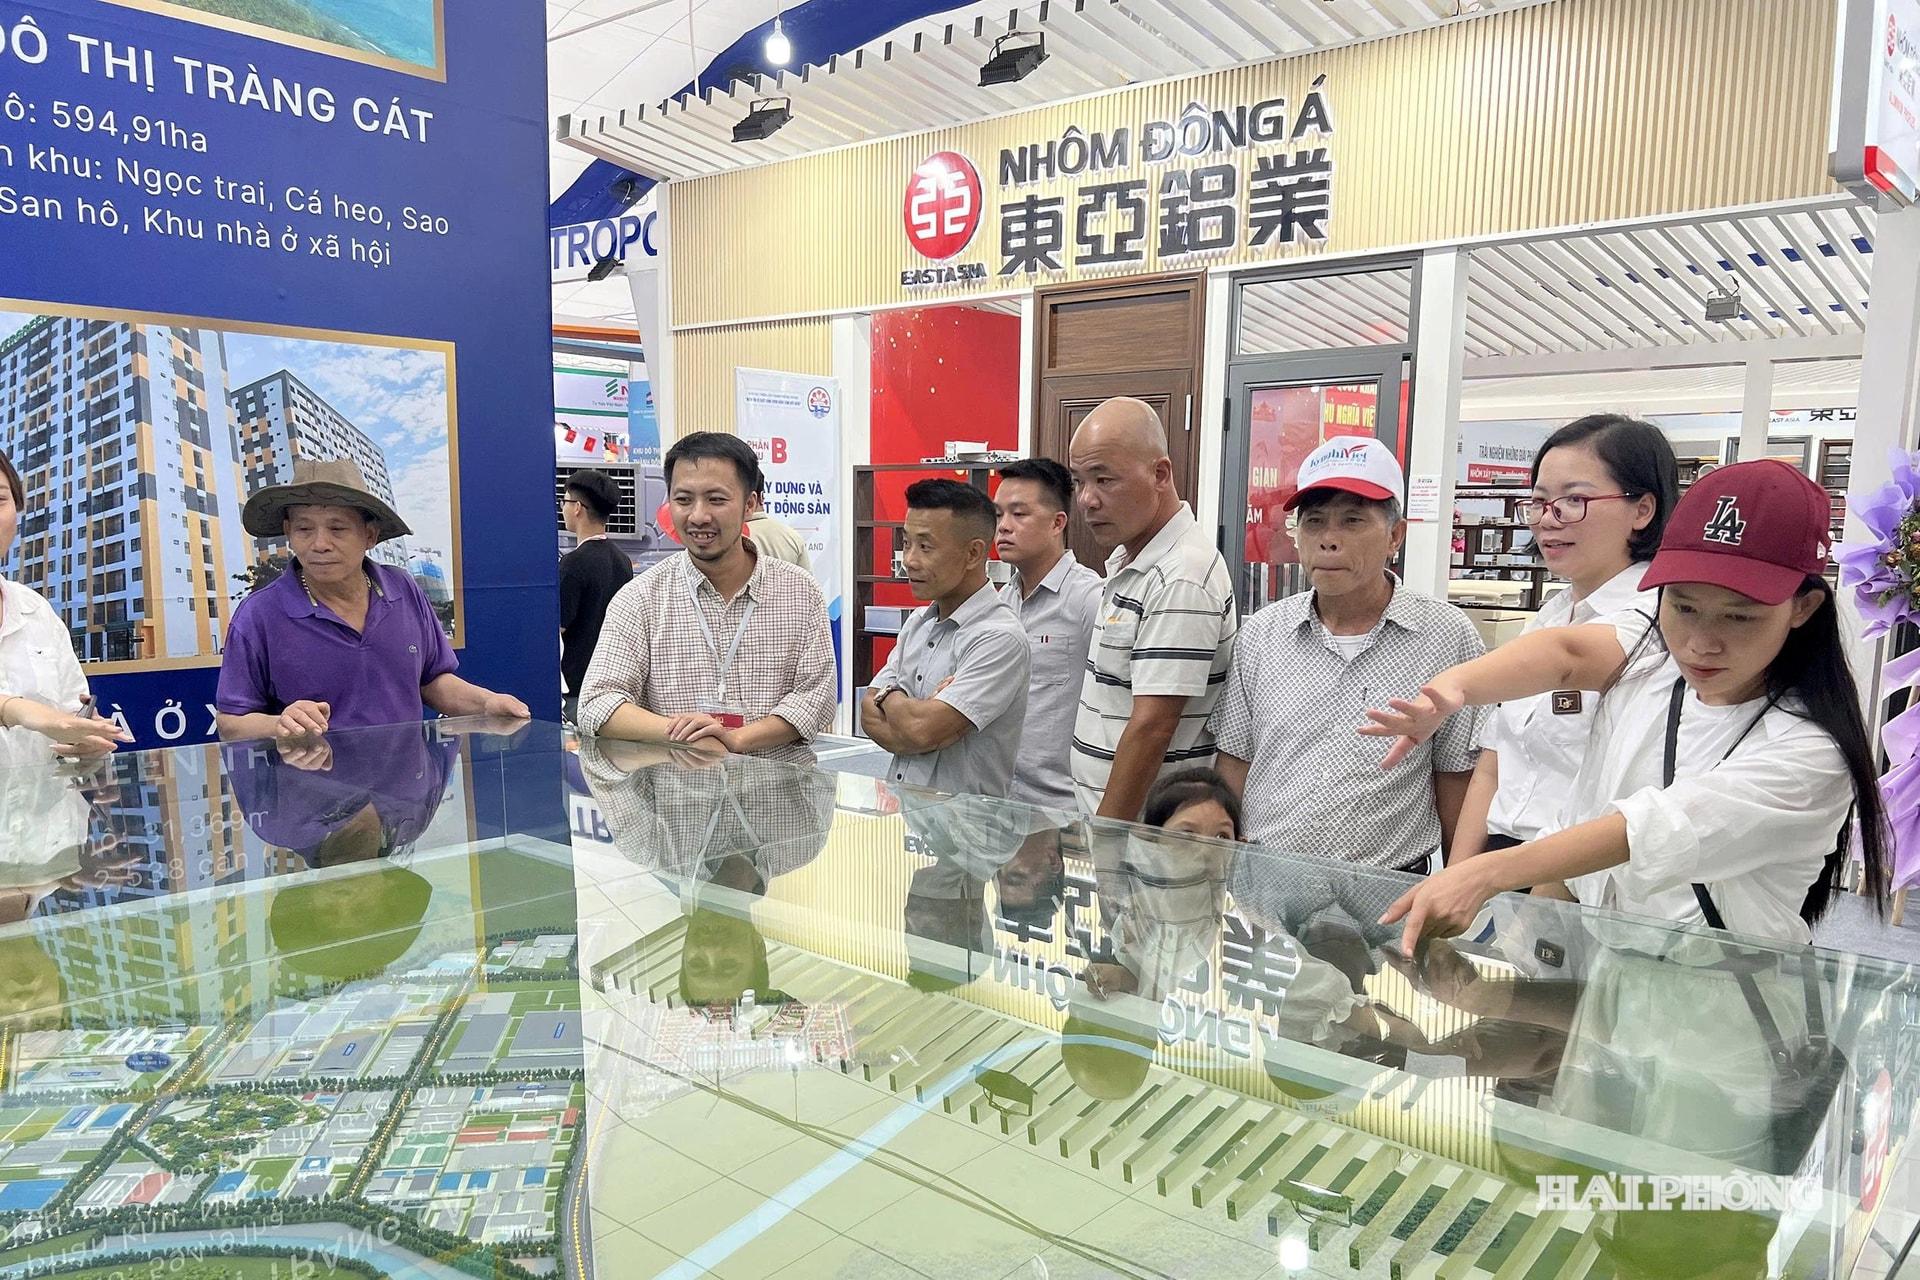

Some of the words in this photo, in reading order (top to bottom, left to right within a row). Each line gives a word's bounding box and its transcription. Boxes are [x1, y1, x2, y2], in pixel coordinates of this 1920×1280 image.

[0, 16, 48, 66] Ô
[68, 33, 156, 93] THỊ
[174, 56, 336, 123] TRÀNG
[352, 96, 434, 143] CÁT
[51, 102, 208, 154] 594,91ha
[1000, 124, 1129, 187] NHÔM
[29, 143, 102, 180] khu:
[118, 158, 203, 199] Ngọc
[214, 173, 274, 211] trai,
[285, 186, 322, 214] Cá
[334, 196, 391, 231] heo,
[402, 207, 450, 236] Sao
[0, 186, 62, 220] San
[78, 199, 130, 235] hô,
[144, 207, 204, 240] Khu
[217, 222, 271, 250] nhà
[281, 228, 299, 253] ở
[309, 234, 340, 258] xã
[352, 236, 391, 268] hội
[771, 437, 787, 463] B
[774, 498, 805, 518] ĐỘNG
[807, 498, 831, 514] SẢN
[775, 481, 806, 498] DỰNG
[808, 480, 823, 495] VÀ
[1703, 495, 1747, 546] LA
